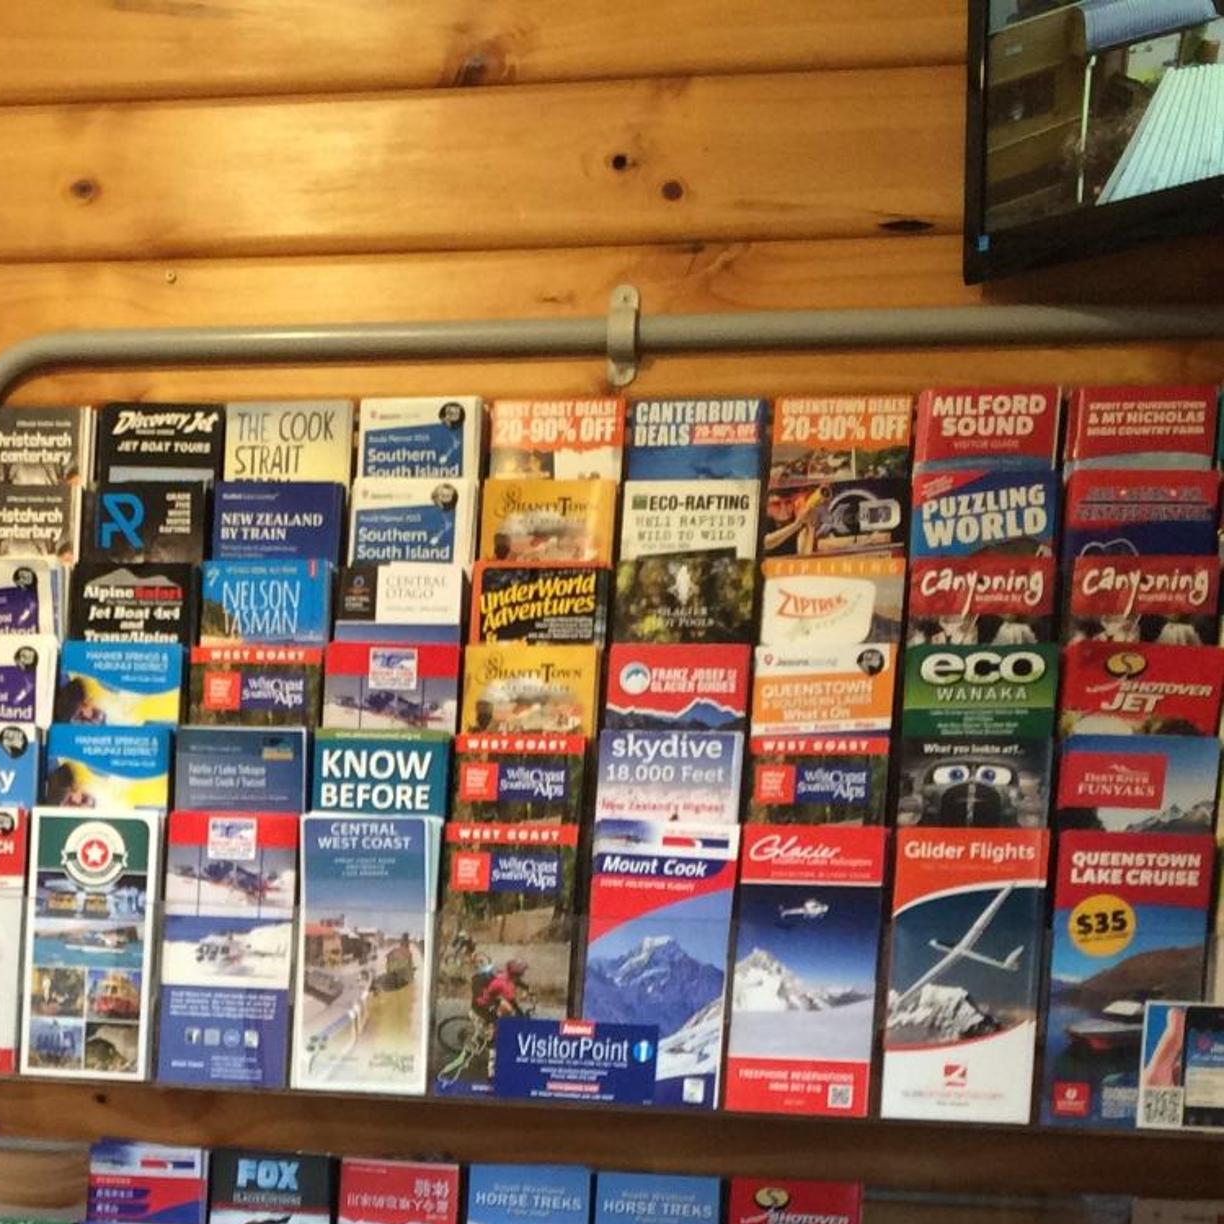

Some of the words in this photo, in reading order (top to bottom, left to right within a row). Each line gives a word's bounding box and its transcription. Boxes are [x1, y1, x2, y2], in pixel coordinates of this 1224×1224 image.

[636, 401, 759, 422] CANTERBURY
[933, 395, 1047, 416] MILFORD
[238, 412, 272, 441] THE
[278, 411, 335, 442] COOK
[941, 416, 1034, 436] SOUND
[1089, 413, 1099, 423] &
[1103, 412, 1123, 423] MT
[1126, 412, 1205, 424] NICHOLAS
[496, 418, 575, 443] 20-90%
[581, 418, 615, 442] OFF
[634, 425, 689, 446] DEALS
[782, 417, 866, 441] 20-90%
[871, 416, 907, 439] OFF
[117, 442, 137, 451] JET
[141, 442, 170, 452] BOAT
[174, 442, 211, 453] TOURS
[367, 449, 436, 462] Southern
[234, 445, 304, 475] STRAIT
[648, 495, 749, 511] ECO-RAFTING
[923, 484, 1045, 520] PUZZLING
[221, 513, 252, 525] NEW
[256, 514, 323, 527] ZEALAND
[923, 507, 1047, 548] WORLD
[221, 527, 240, 539] BY
[243, 527, 286, 539] TRAIN
[359, 529, 427, 542] Southern
[357, 546, 402, 559] South
[405, 546, 450, 559] Island
[222, 581, 301, 608] NELSON
[481, 574, 596, 615] UnderWorld
[114, 606, 150, 620] Boat
[232, 608, 299, 635] TASMAN
[482, 596, 596, 632] Adventures
[921, 652, 1045, 685] eco
[762, 682, 873, 698] QUEENSTOWN
[936, 688, 1027, 700] WANAKA
[1119, 682, 1213, 695] SHOTOVER
[1100, 694, 1164, 712] JET
[468, 740, 508, 749] WEST
[516, 740, 567, 749] COAST
[612, 734, 722, 763] skydive
[763, 741, 805, 750] WEST
[322, 749, 432, 780] KNOW
[607, 766, 674, 783] 18,000
[681, 766, 724, 783] Feet
[321, 783, 430, 809] BEFORE
[331, 822, 397, 836] CENTRAL
[459, 829, 500, 840] WEST
[508, 830, 559, 841] COAST
[318, 837, 361, 848] WEST
[365, 837, 412, 849] COAST
[905, 841, 964, 858] Glider
[970, 842, 1035, 862] Flights
[603, 856, 658, 875] Mount
[665, 859, 707, 877] Cook
[1071, 850, 1202, 869] QUEENSTOWN
[1071, 868, 1121, 886] LAKE
[1126, 869, 1200, 887] CRUISE
[1076, 909, 1129, 935] $35
[517, 1032, 628, 1062] VisitorPoint
[236, 1159, 299, 1190] FOX
[476, 1192, 527, 1208] HORSE
[534, 1195, 581, 1211] TREKS
[603, 1201, 657, 1216] HORSE
[662, 1204, 712, 1218] TREKS
